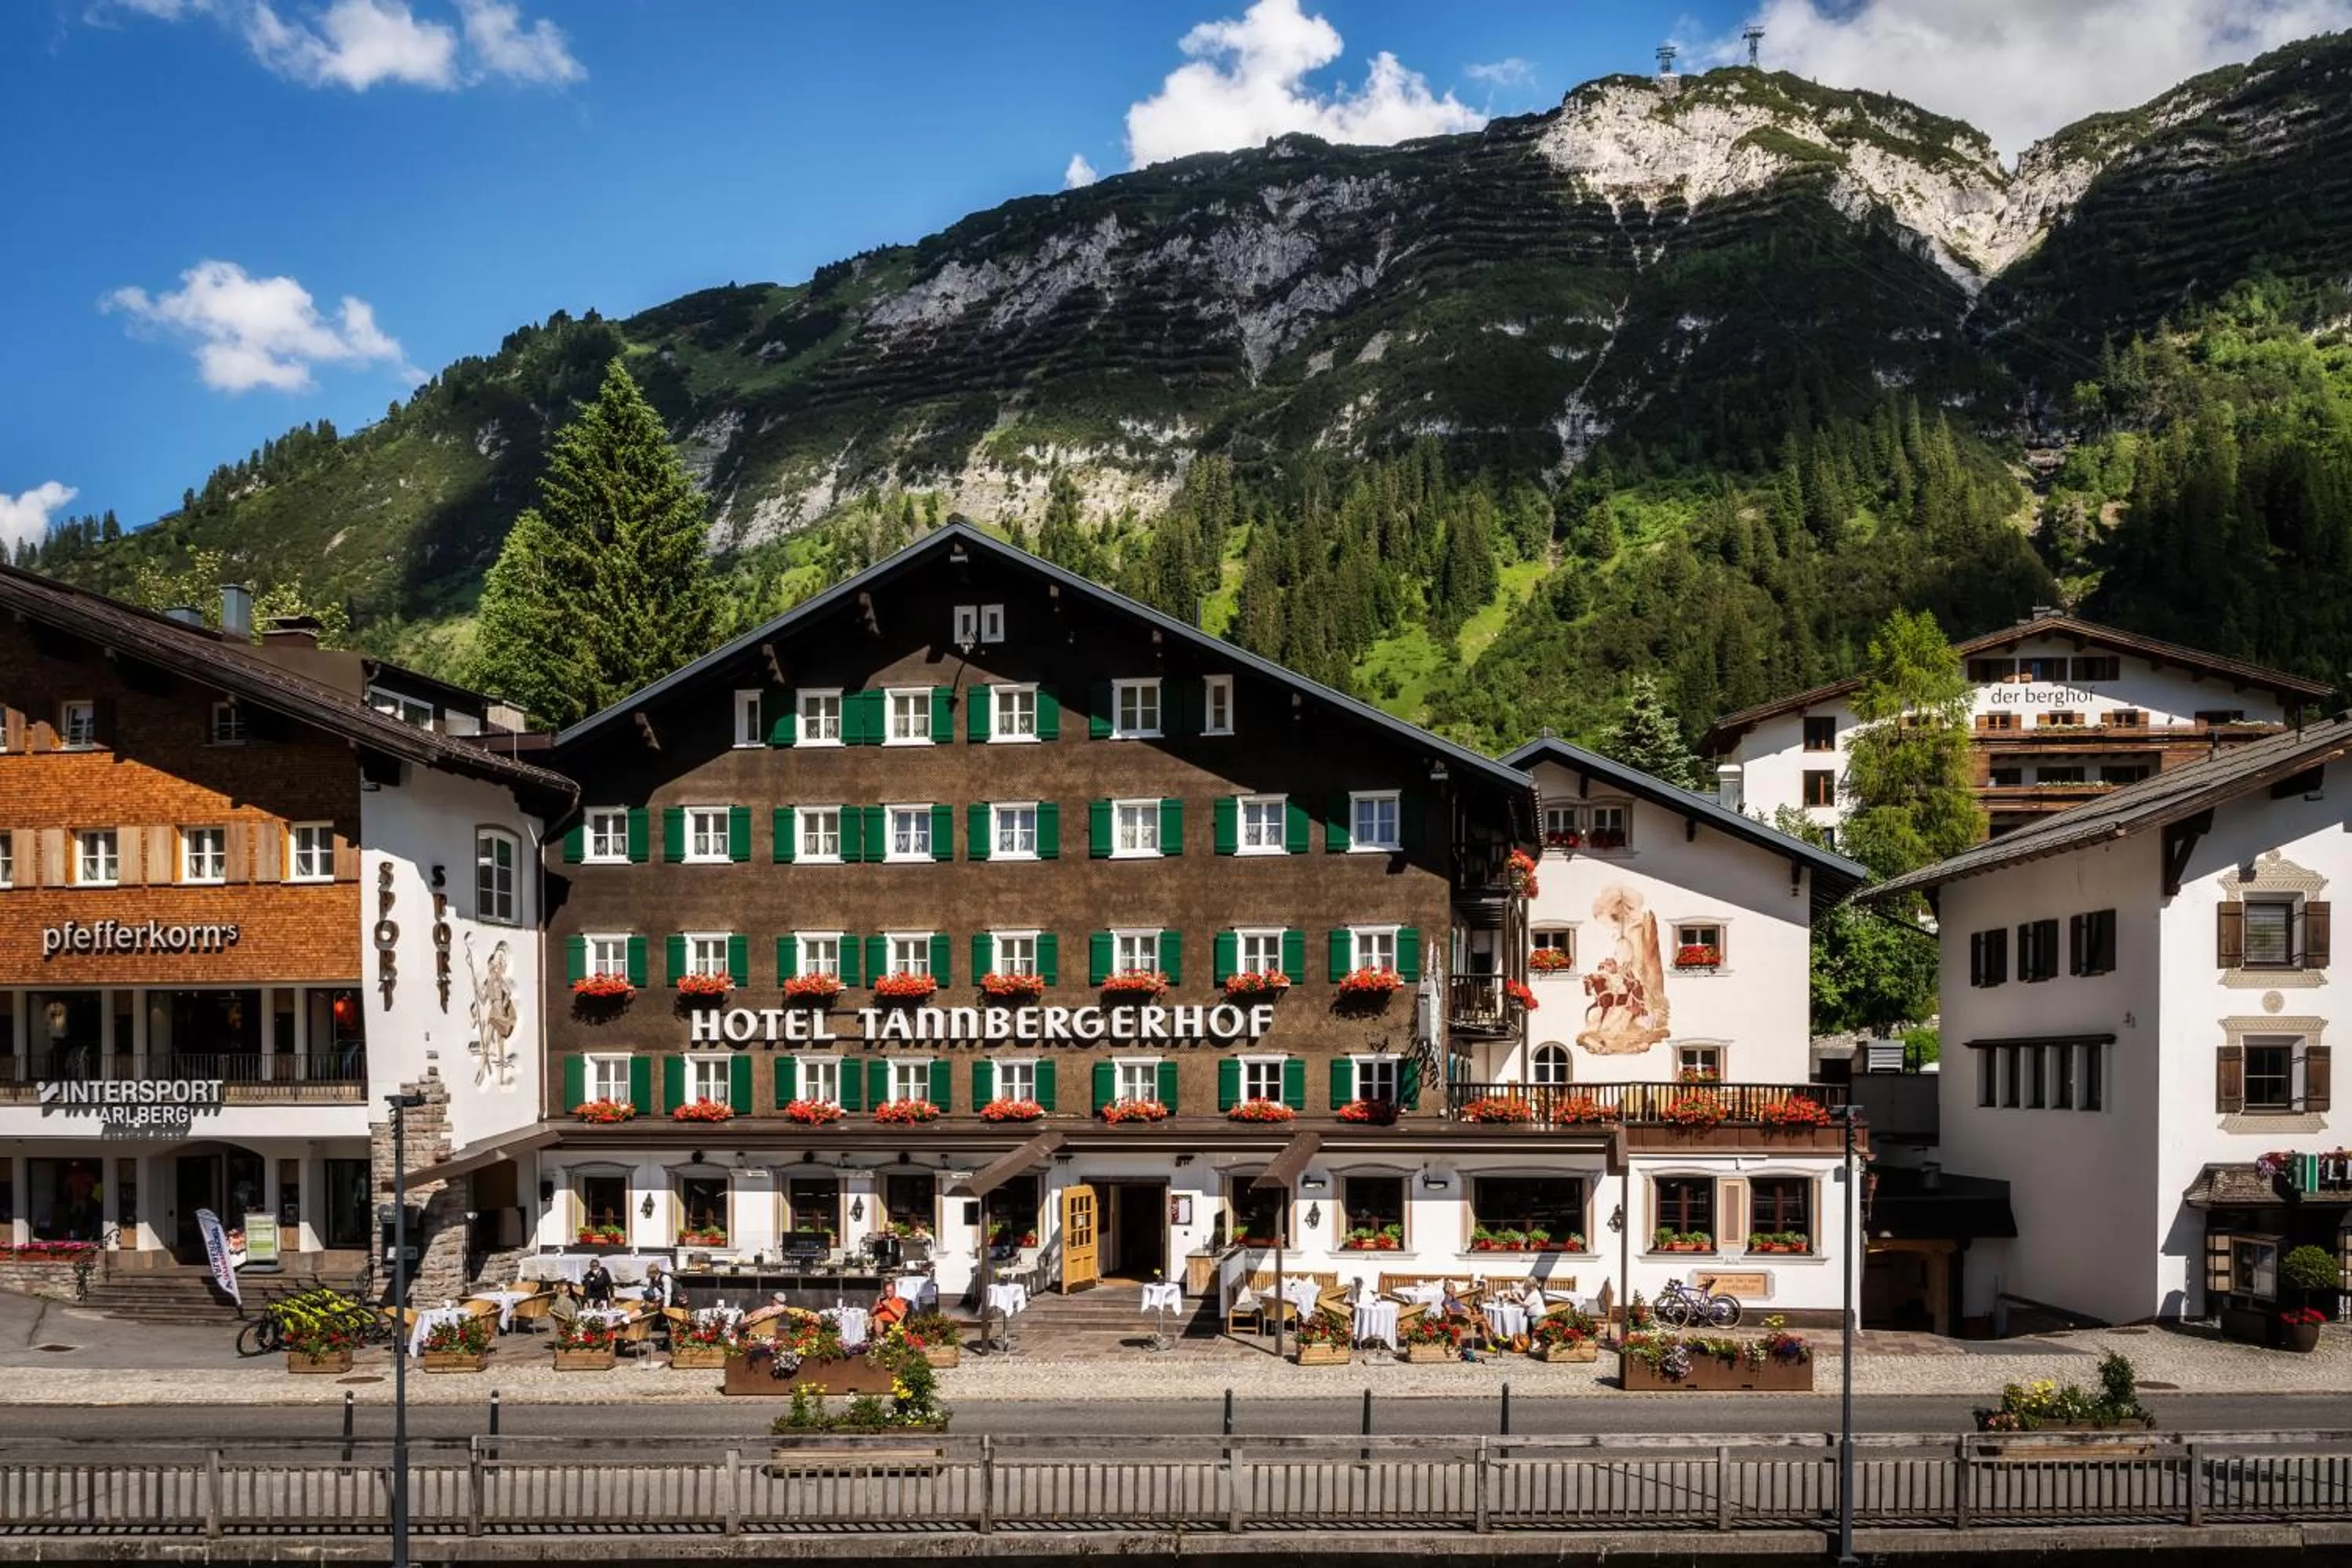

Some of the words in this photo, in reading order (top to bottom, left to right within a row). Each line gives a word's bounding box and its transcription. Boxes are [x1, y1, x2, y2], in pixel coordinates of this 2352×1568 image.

[1991, 687, 2020, 704] der
[2025, 684, 2096, 707] berghof
[691, 1008, 837, 1041] HOTEL
[62, 1080, 223, 1103] INTERSPORT
[100, 1105, 189, 1123] ARLBERG
